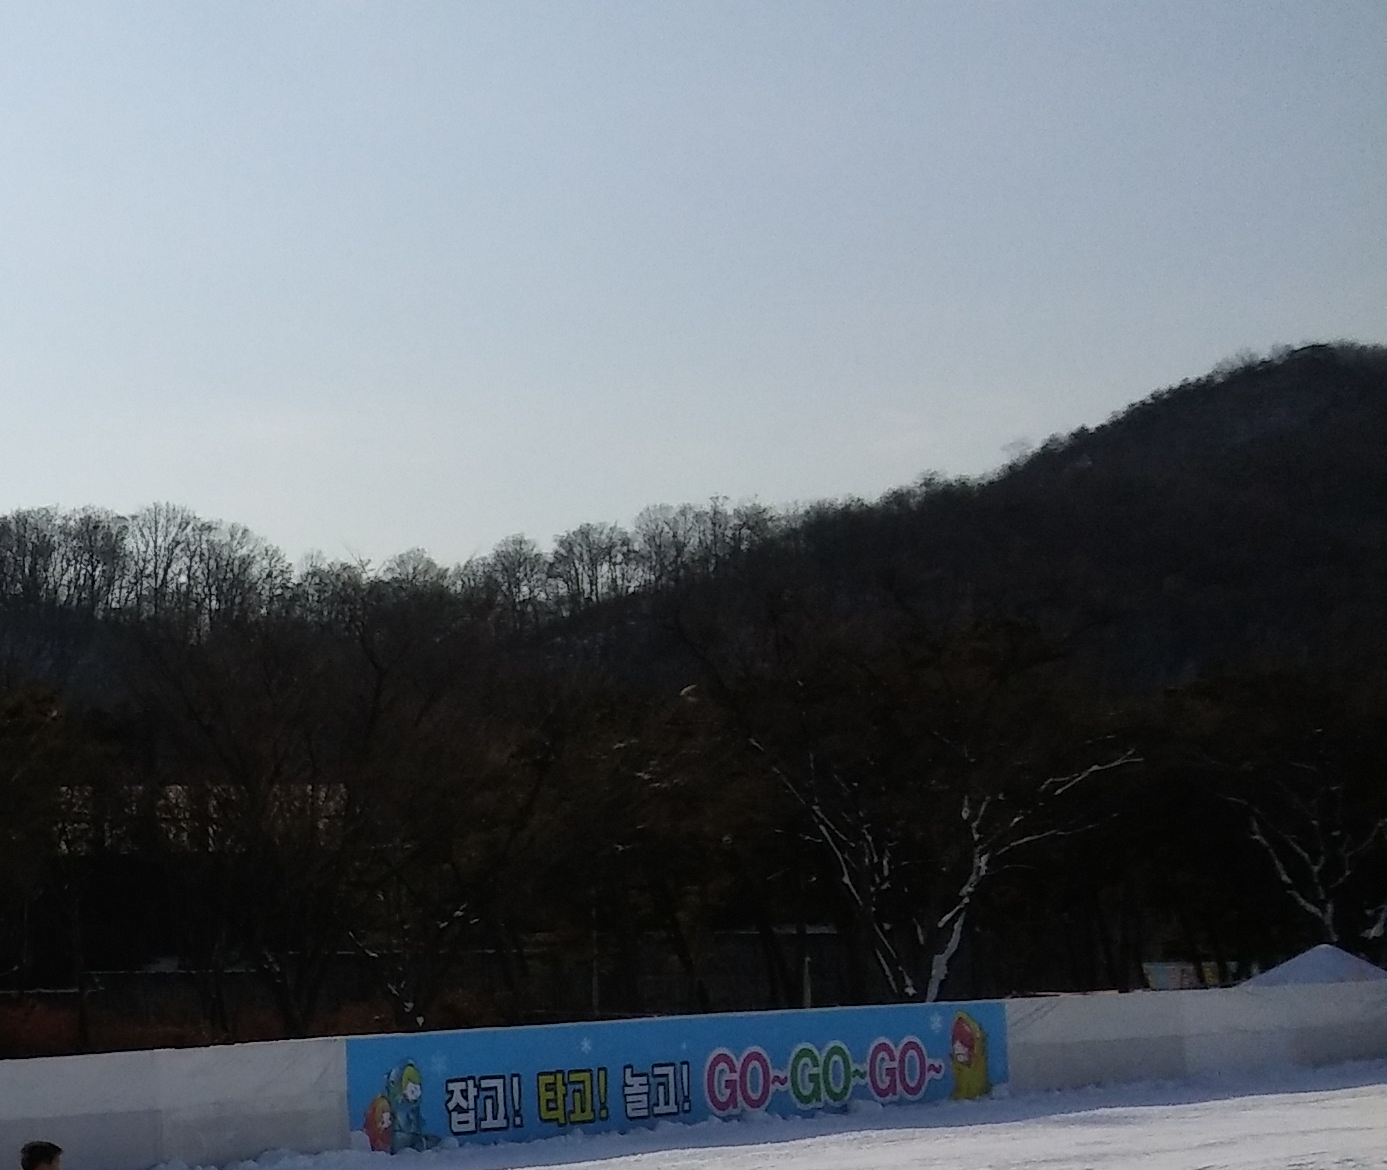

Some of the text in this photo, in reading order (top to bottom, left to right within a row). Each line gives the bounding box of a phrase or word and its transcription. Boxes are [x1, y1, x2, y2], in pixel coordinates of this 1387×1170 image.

[445, 1073, 523, 1135] 잡고!
[536, 1067, 608, 1126] 타고!
[622, 1060, 692, 1119] 놀고!
